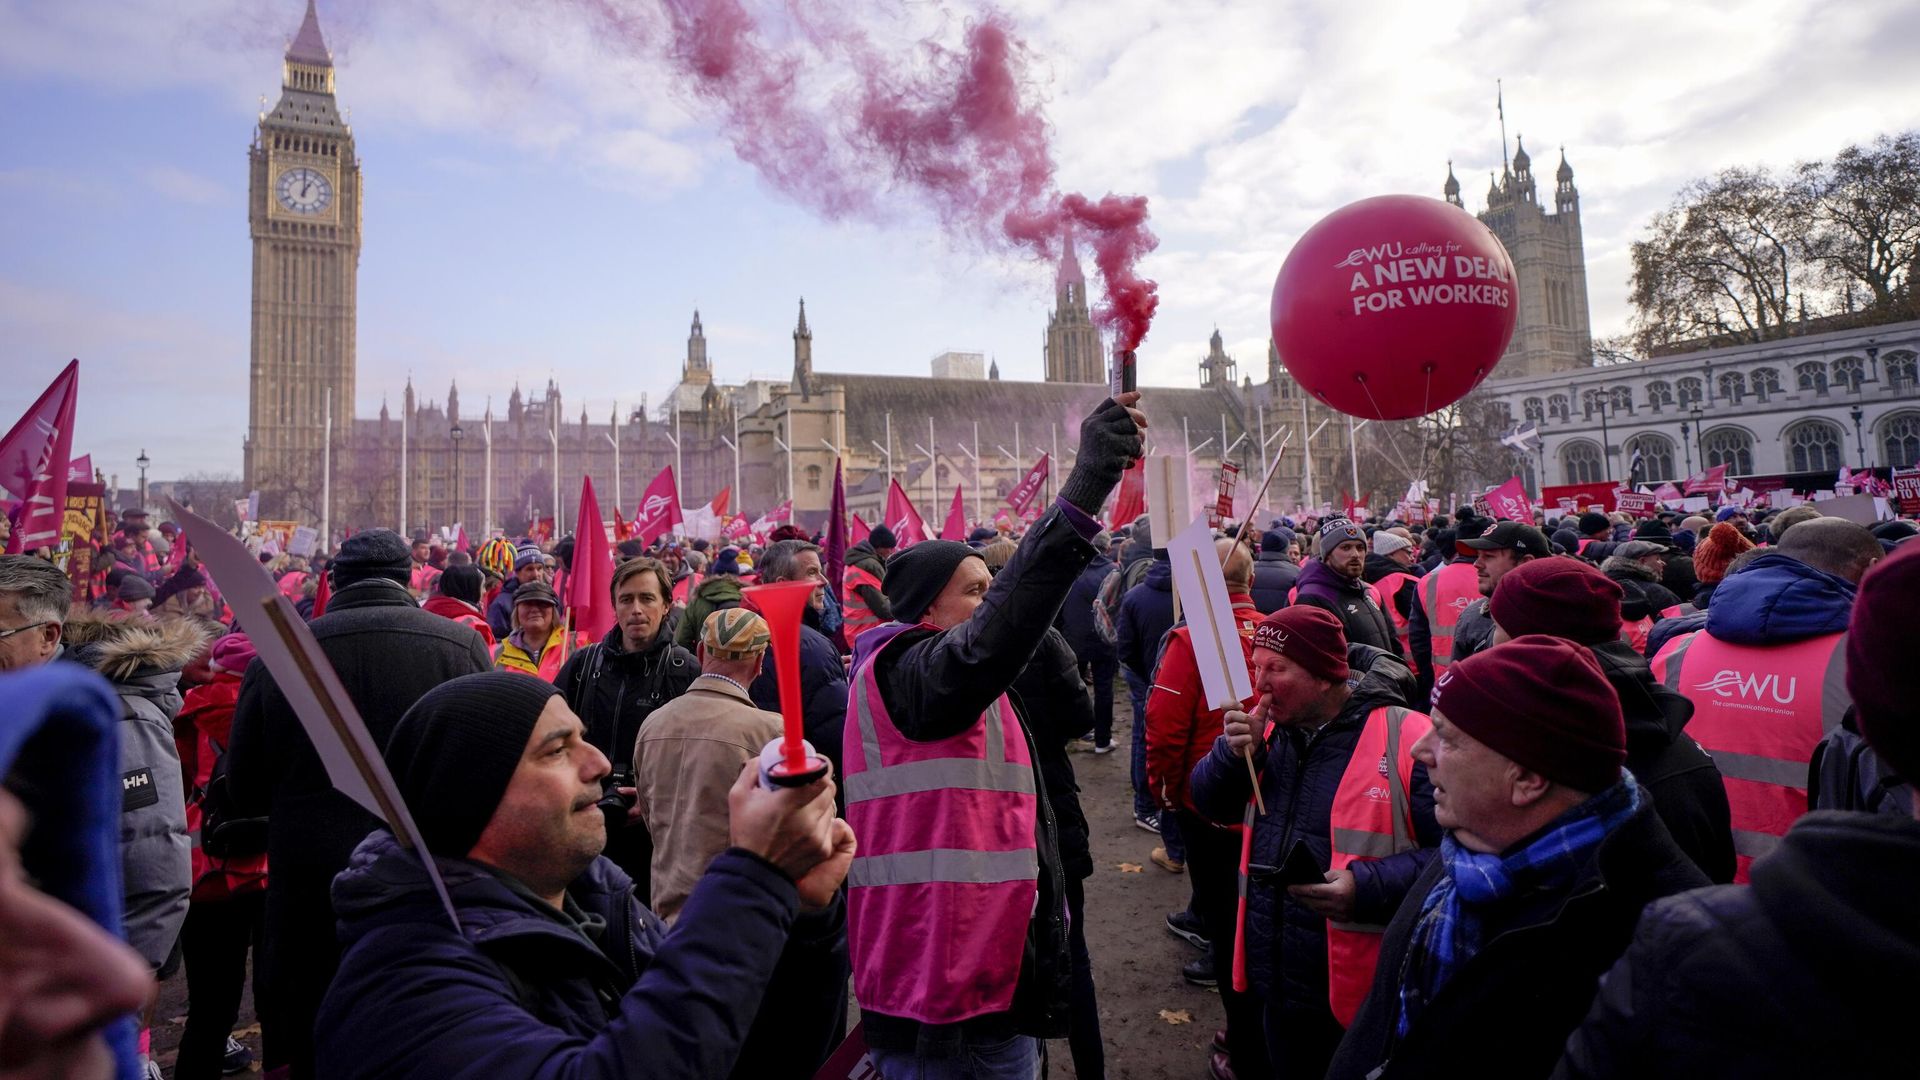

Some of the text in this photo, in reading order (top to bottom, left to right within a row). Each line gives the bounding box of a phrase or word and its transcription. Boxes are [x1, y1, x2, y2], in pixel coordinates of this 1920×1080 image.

[1344, 241, 1462, 267] CWU calling for
[1350, 256, 1509, 291] A NEW DEAL
[1353, 284, 1509, 316] FOR WORKERS
[1897, 478, 1920, 489] STRI
[1899, 489, 1913, 499] TO
[1257, 625, 1289, 641] CWU
[1702, 670, 1796, 703] CWU
[1722, 703, 1774, 713] communications
[123, 773, 148, 789] HH
[1365, 787, 1391, 799] CW
